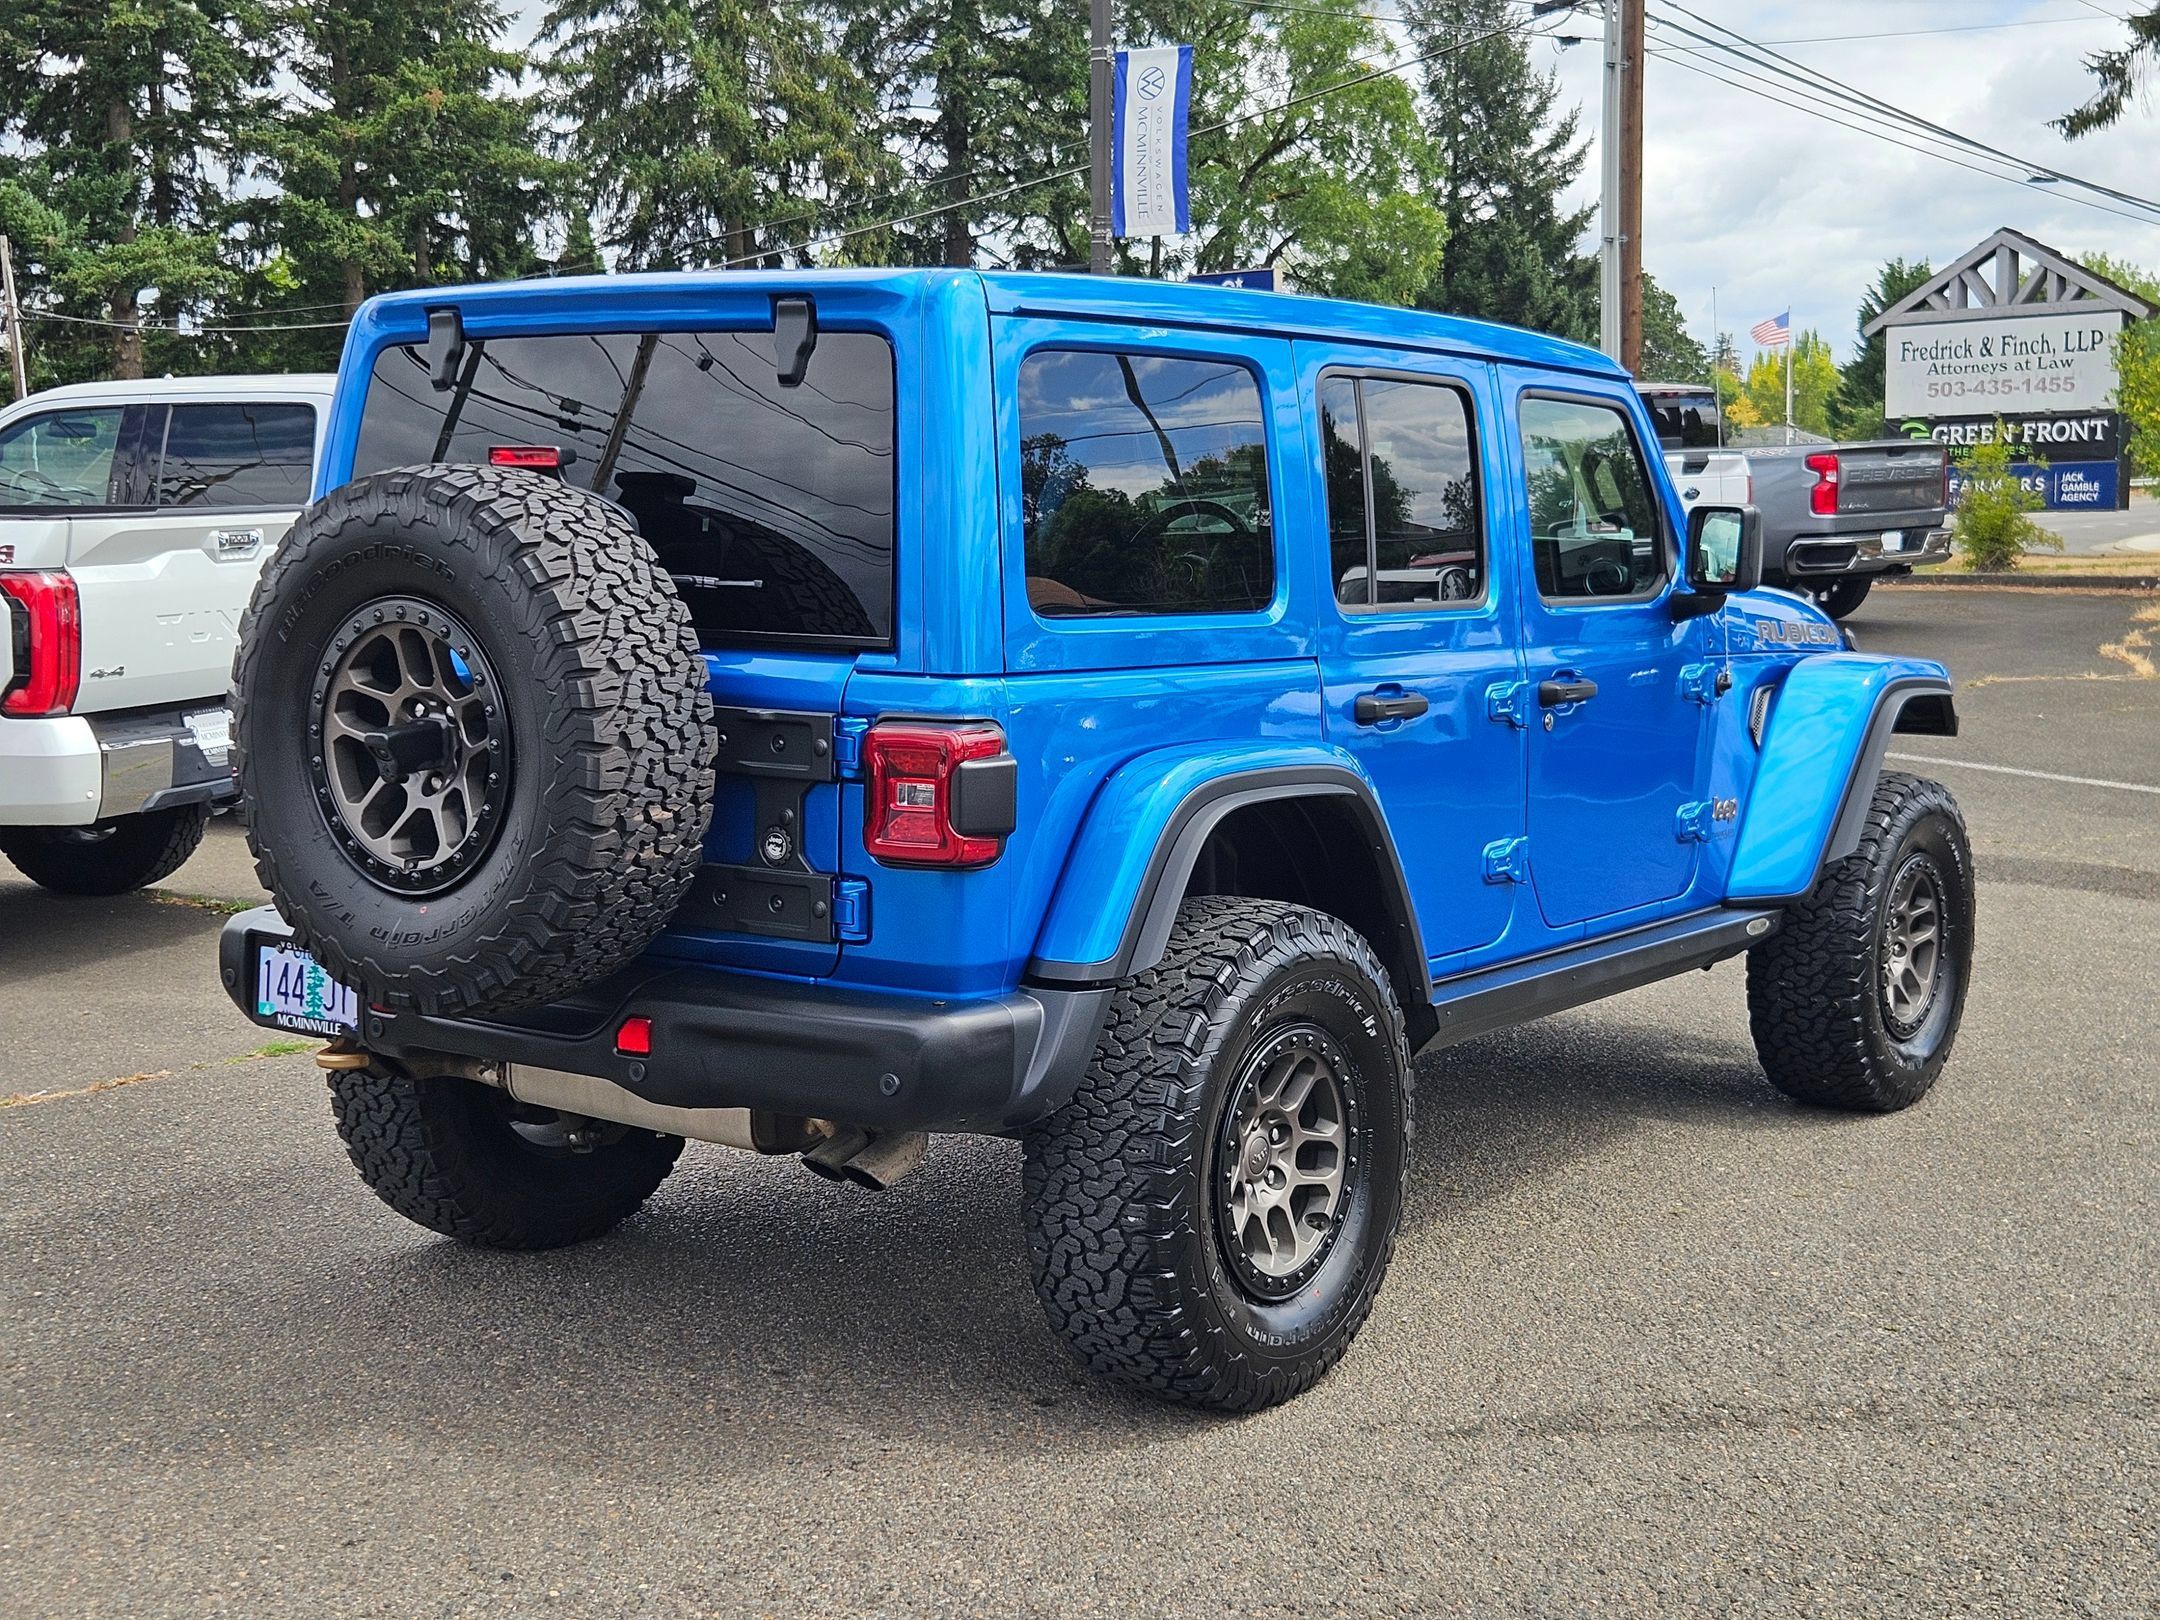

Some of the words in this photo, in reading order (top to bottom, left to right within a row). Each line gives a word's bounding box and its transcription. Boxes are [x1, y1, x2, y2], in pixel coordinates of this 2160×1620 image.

[1137, 106, 1149, 220] MCMINNVILLE
[1155, 106, 1163, 212] VOLKSWAGEN
[1900, 337, 1973, 362] Fredrick
[1979, 335, 1994, 358] &
[2000, 332, 2056, 358] Finch,
[2063, 329, 2104, 353] LLP
[1926, 359, 2008, 376] Attorneys
[2014, 358, 2031, 371] at
[2037, 356, 2075, 370] Law
[1927, 376, 2076, 399] 503-435-1455
[1931, 421, 2015, 446] GREEN
[2021, 417, 2109, 443] FRONT
[1849, 466, 1941, 482] CHEVROLET
[2061, 471, 2084, 482] JACK
[2061, 482, 2100, 492] GAMBLE
[2061, 491, 2099, 502] AGENCY
[1755, 619, 1838, 645] RUBICON
[1711, 795, 1737, 824] Jeep
[266, 960, 305, 1007] 144
[277, 1014, 341, 1035] MCMINNVILLE
